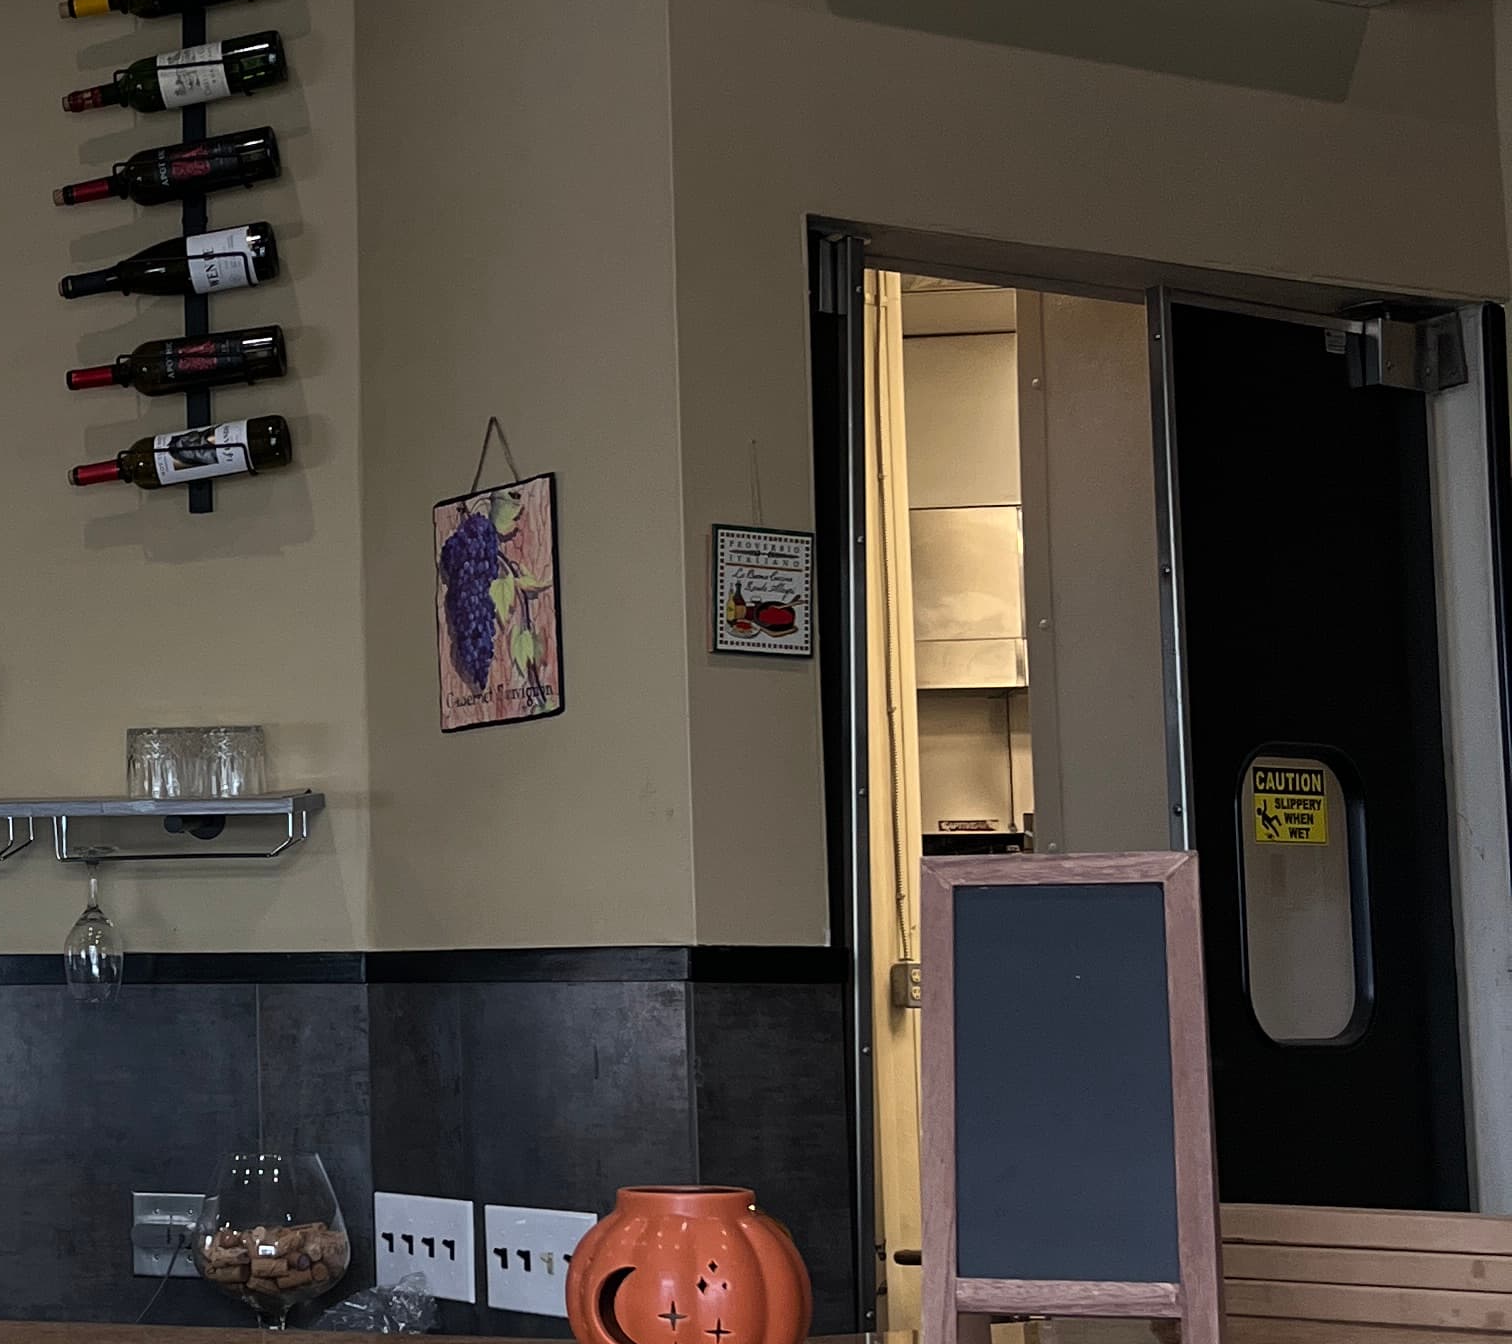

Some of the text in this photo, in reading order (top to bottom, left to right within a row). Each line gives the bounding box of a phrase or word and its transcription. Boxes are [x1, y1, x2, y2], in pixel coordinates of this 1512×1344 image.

[1255, 770, 1322, 793] CAUTION
[1274, 798, 1322, 811] SLIPPERY
[1284, 812, 1314, 825] WHEN
[1289, 827, 1311, 840] WET
